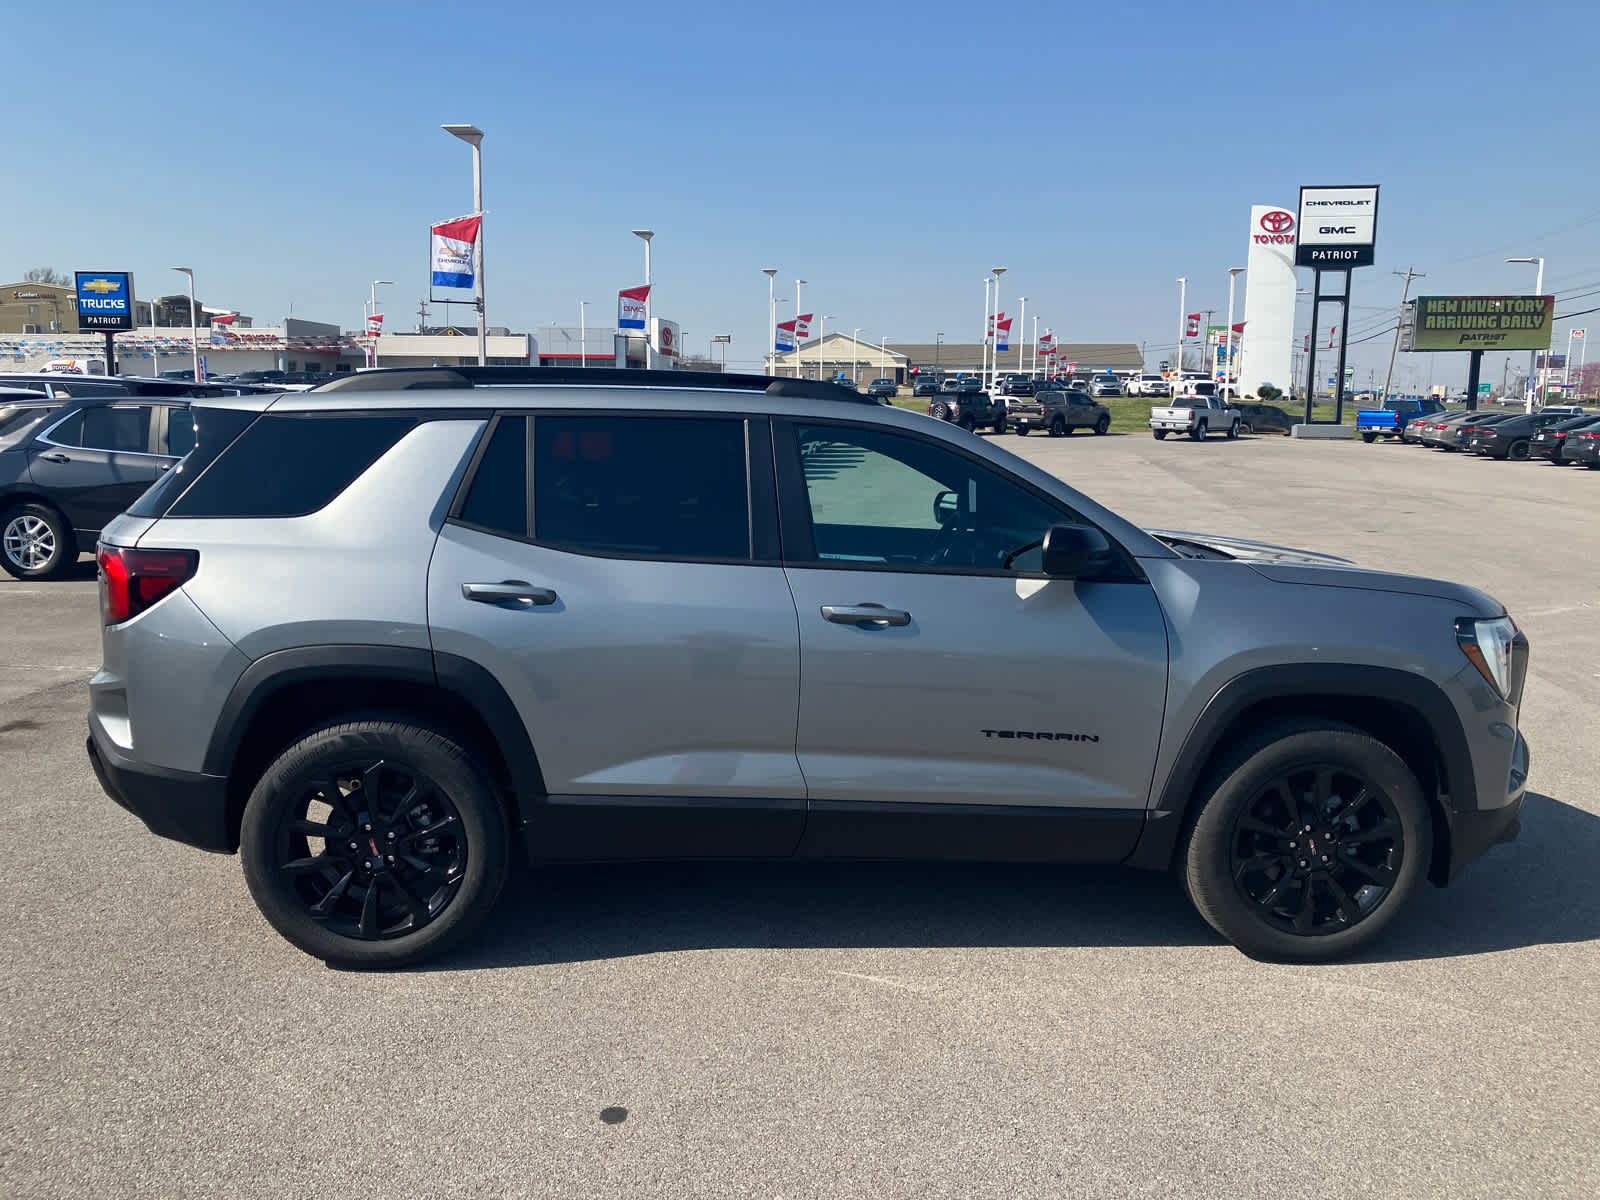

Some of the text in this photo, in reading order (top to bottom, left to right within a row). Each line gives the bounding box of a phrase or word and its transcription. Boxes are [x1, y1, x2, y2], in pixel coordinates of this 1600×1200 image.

[1319, 226, 1356, 234] GMC
[1312, 250, 1359, 260] PATRIOT
[80, 298, 126, 309] TRUCKS
[623, 305, 644, 313] GMC
[1426, 299, 1545, 313] NEW INVENTORY
[87, 316, 121, 325] PATRIOT
[1425, 314, 1544, 329] ARRIVING DAILY
[1459, 333, 1508, 345] PATRIOT
[980, 729, 1100, 743] TERRAIN
